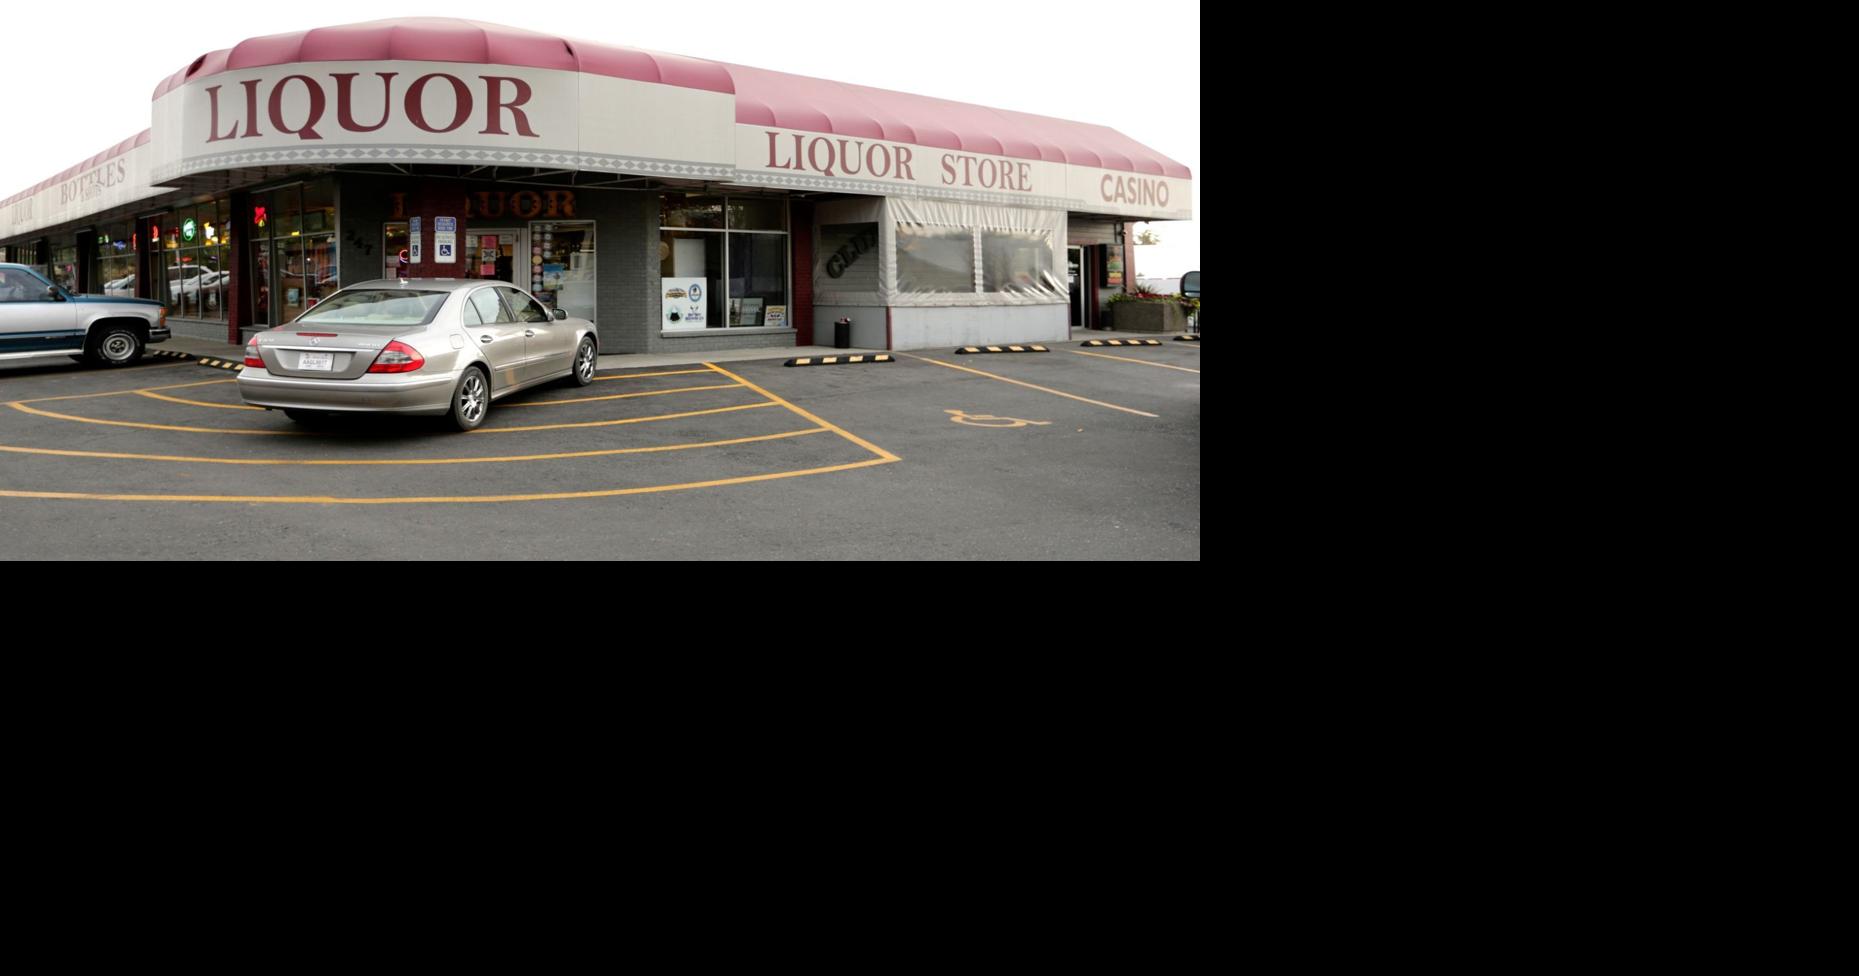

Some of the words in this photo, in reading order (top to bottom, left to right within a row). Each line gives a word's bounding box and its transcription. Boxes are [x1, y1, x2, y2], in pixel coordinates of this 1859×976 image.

[205, 72, 540, 143] LIQUOR
[61, 158, 126, 205] BOTTLES
[765, 131, 916, 181] LIQUOR
[941, 153, 1032, 192] STORE
[1101, 174, 1169, 207] CASINO
